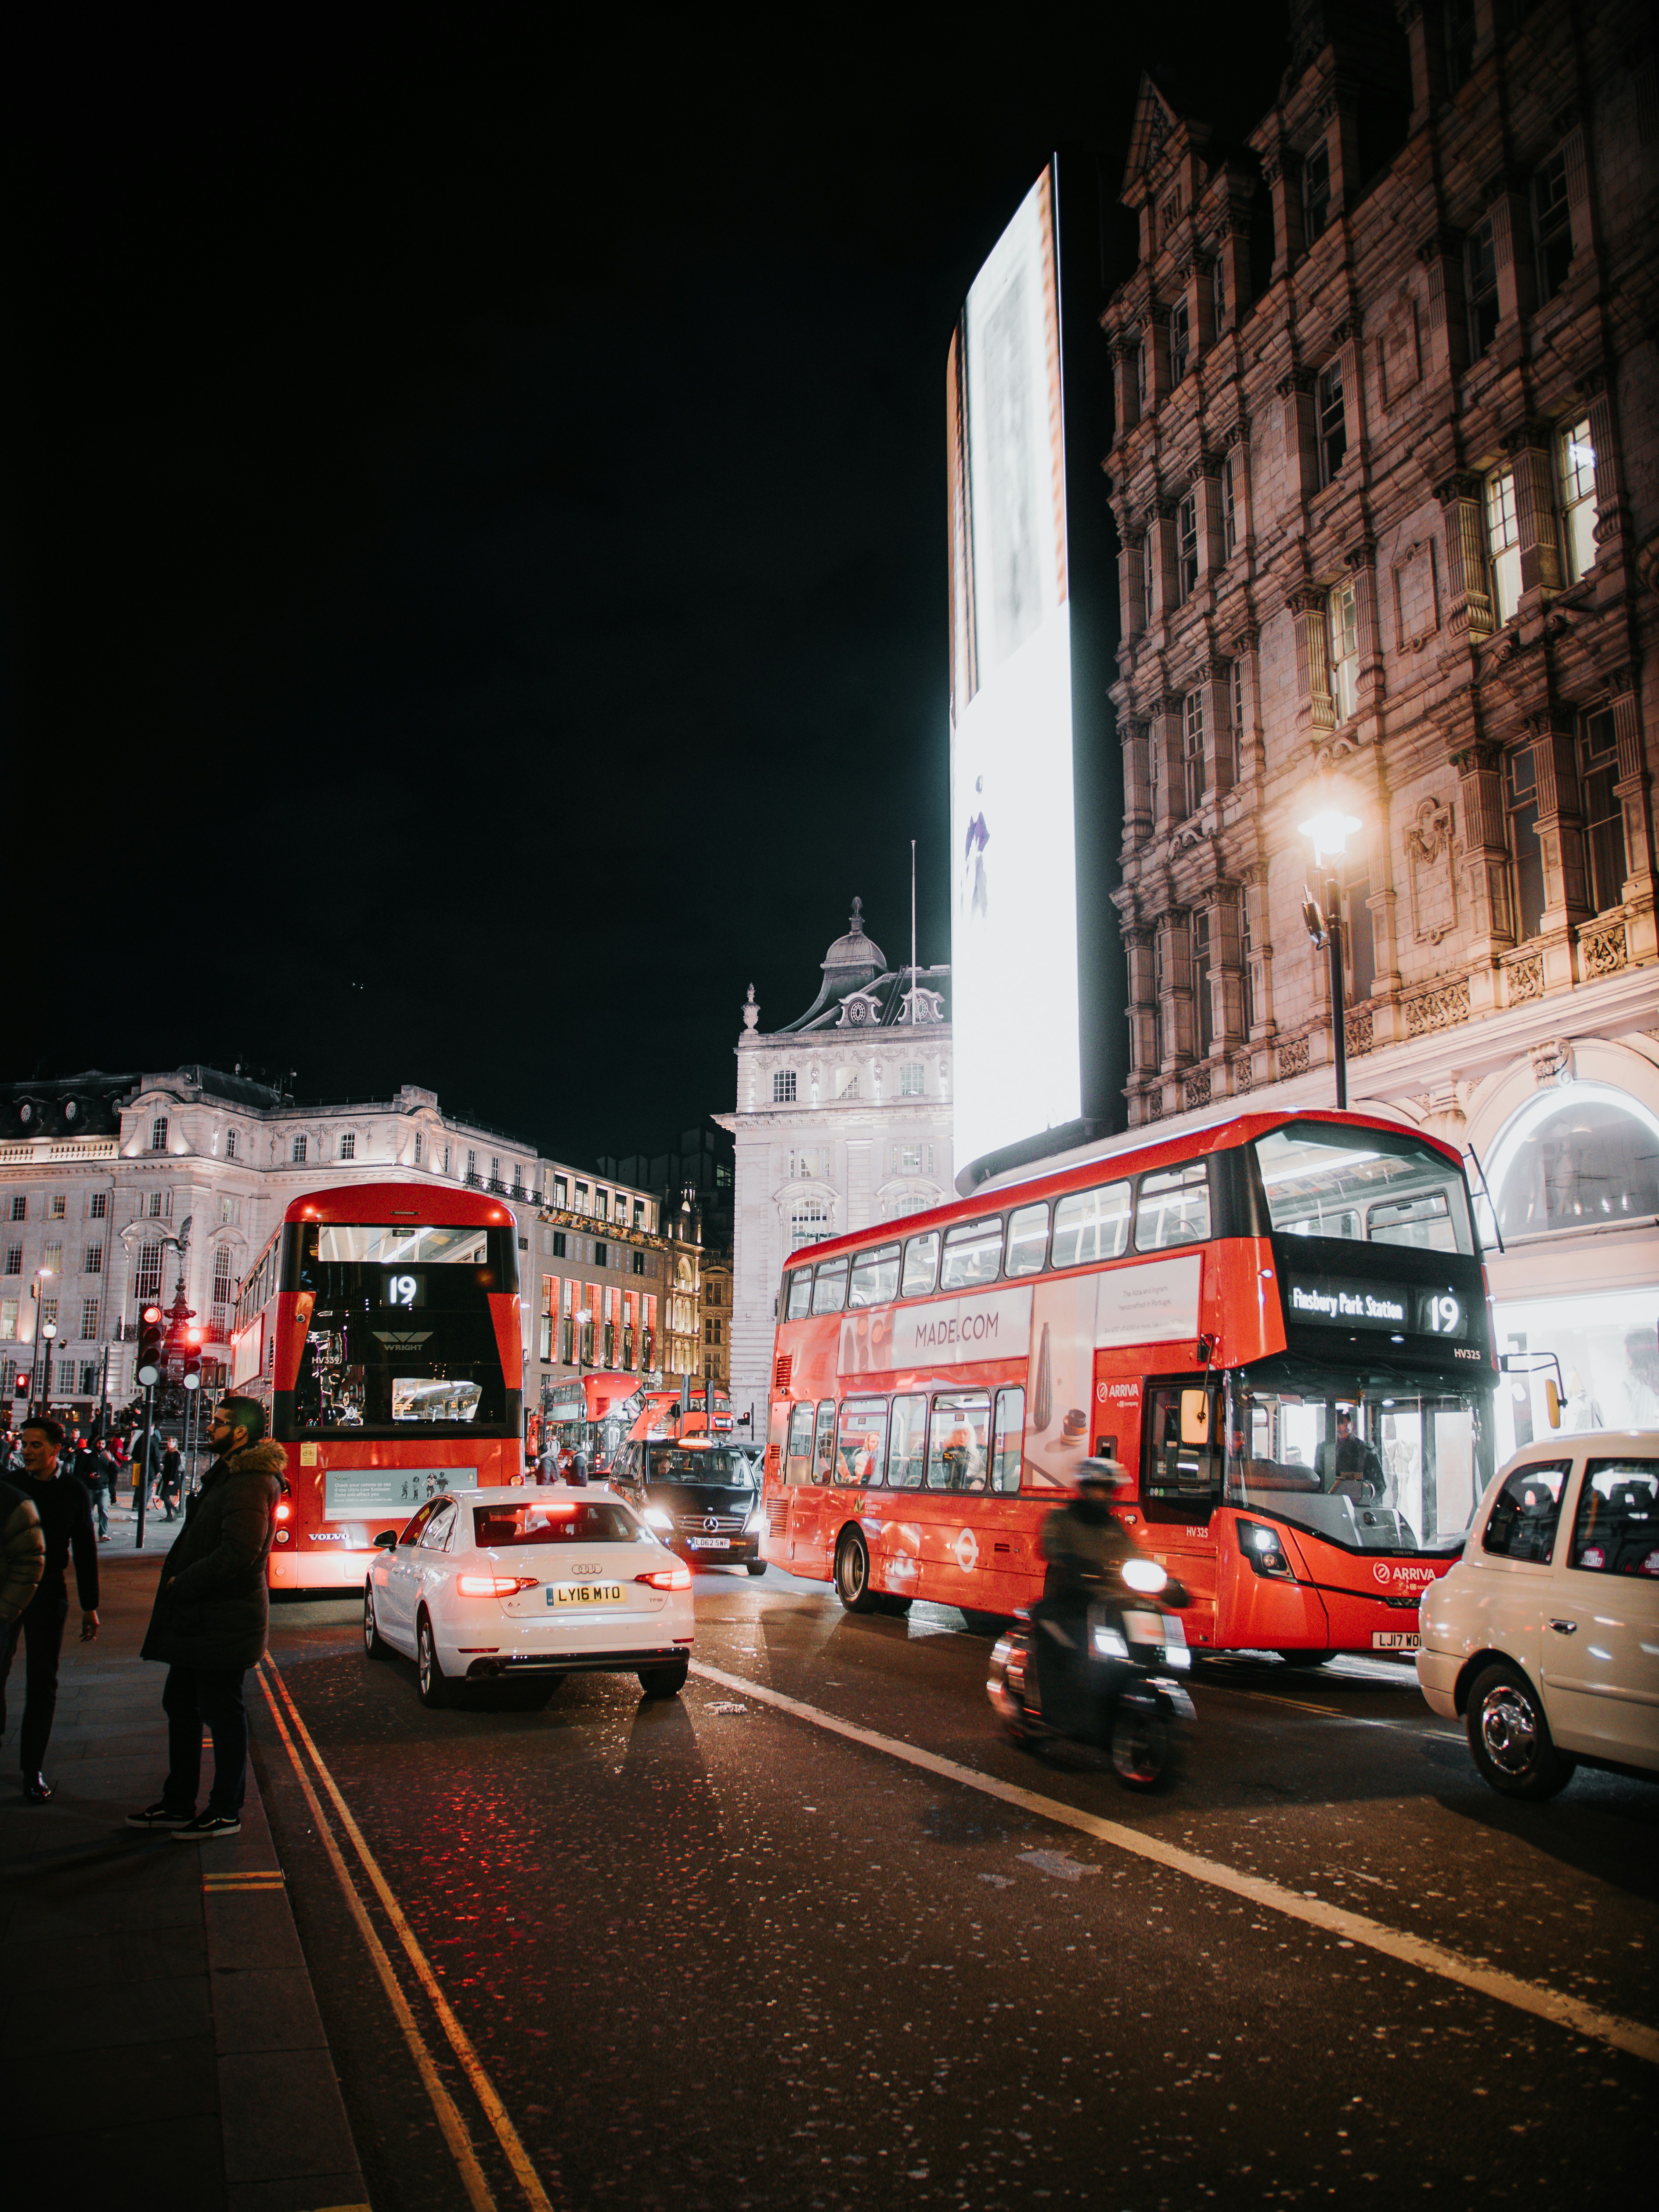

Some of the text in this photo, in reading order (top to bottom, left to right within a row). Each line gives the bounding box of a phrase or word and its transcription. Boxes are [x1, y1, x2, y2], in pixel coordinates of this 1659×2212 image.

[390, 1276, 416, 1303] 19
[1293, 1287, 1403, 1320] Finsbury Park Station
[1432, 1296, 1458, 1332] 19
[915, 1311, 999, 1348] MADE.COM
[1454, 1348, 1481, 1360] HV325
[1108, 1383, 1139, 1397] ARRIVA
[1392, 1567, 1436, 1581] ARRIVA
[559, 1587, 620, 1601] LY16 MTO
[1380, 1634, 1403, 1646] LJ17
